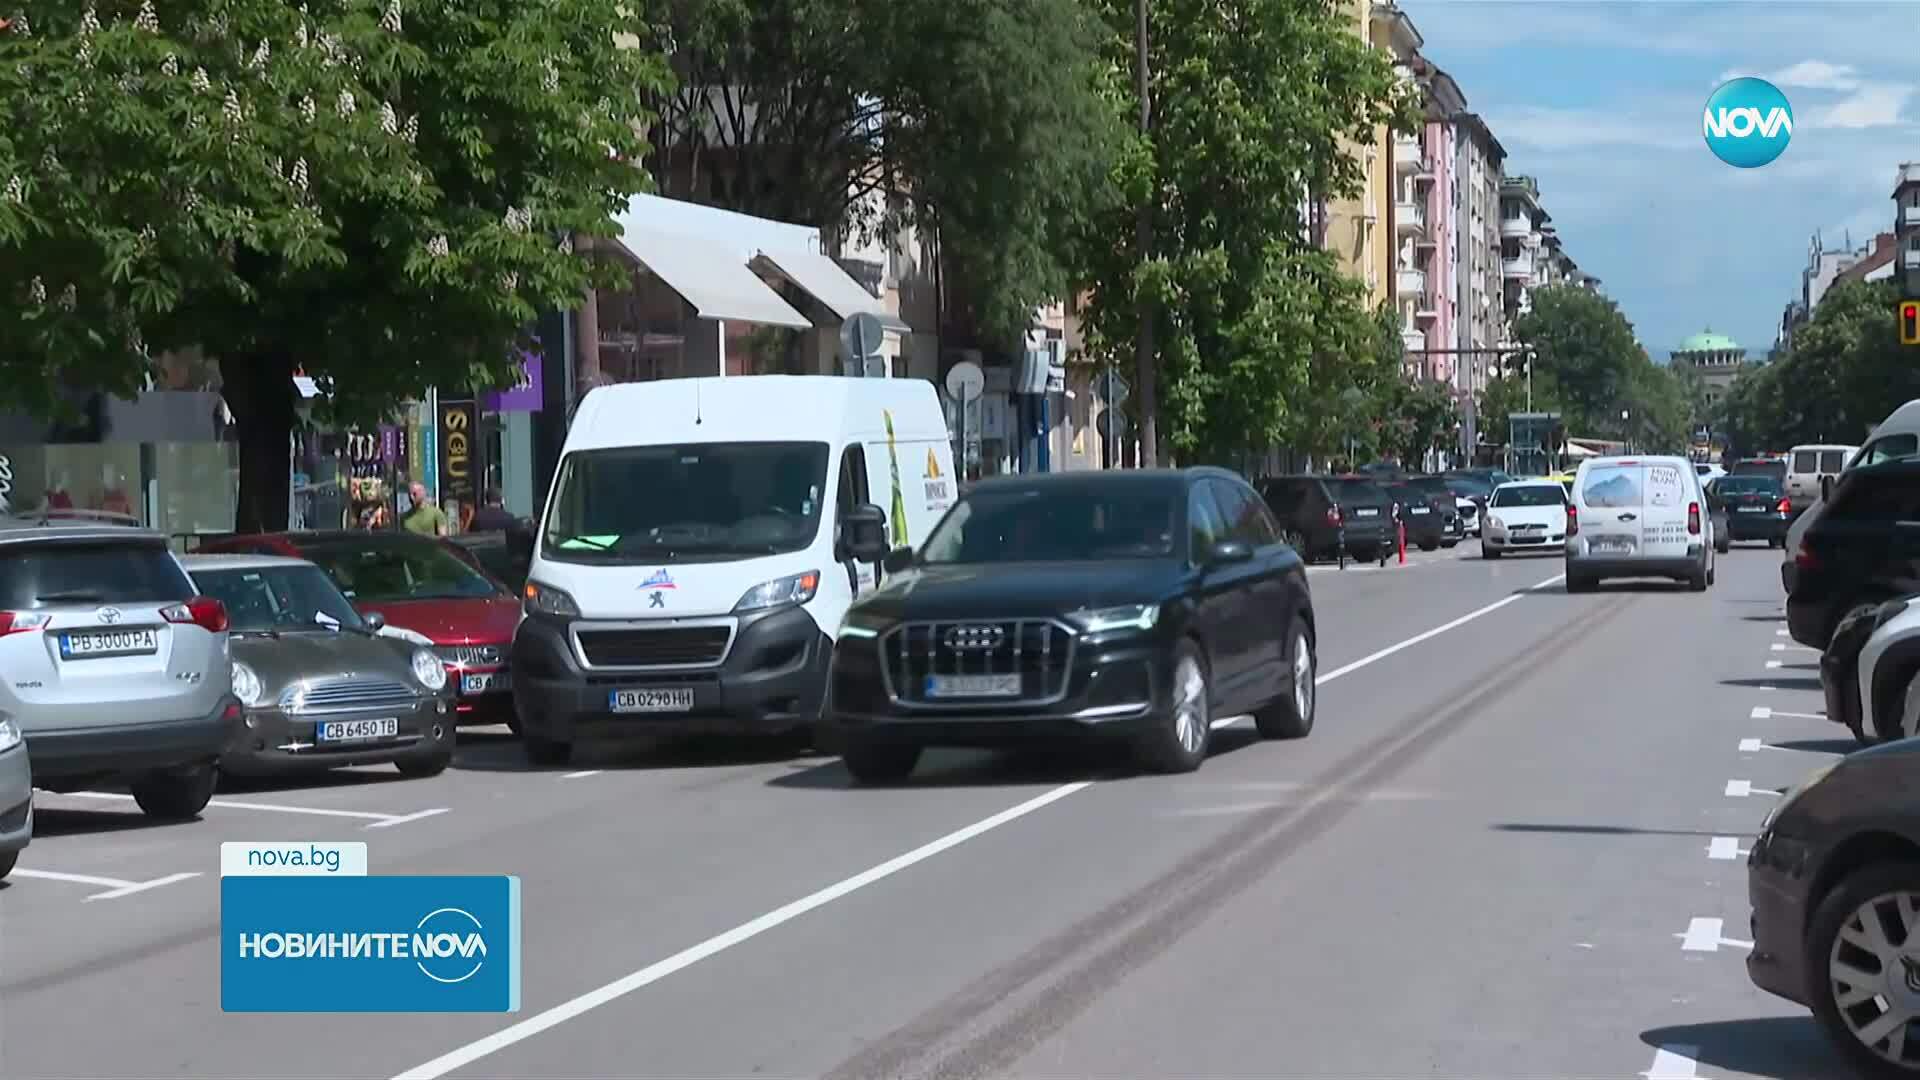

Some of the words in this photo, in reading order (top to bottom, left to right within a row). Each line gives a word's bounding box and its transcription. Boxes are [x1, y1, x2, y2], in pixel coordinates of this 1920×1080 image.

[71, 634, 92, 650] PB
[95, 632, 131, 649] 3000
[133, 630, 153, 647] PA
[467, 676, 483, 689] CB
[326, 723, 344, 738] CB
[346, 721, 378, 737] 6450
[379, 720, 396, 734] TB
